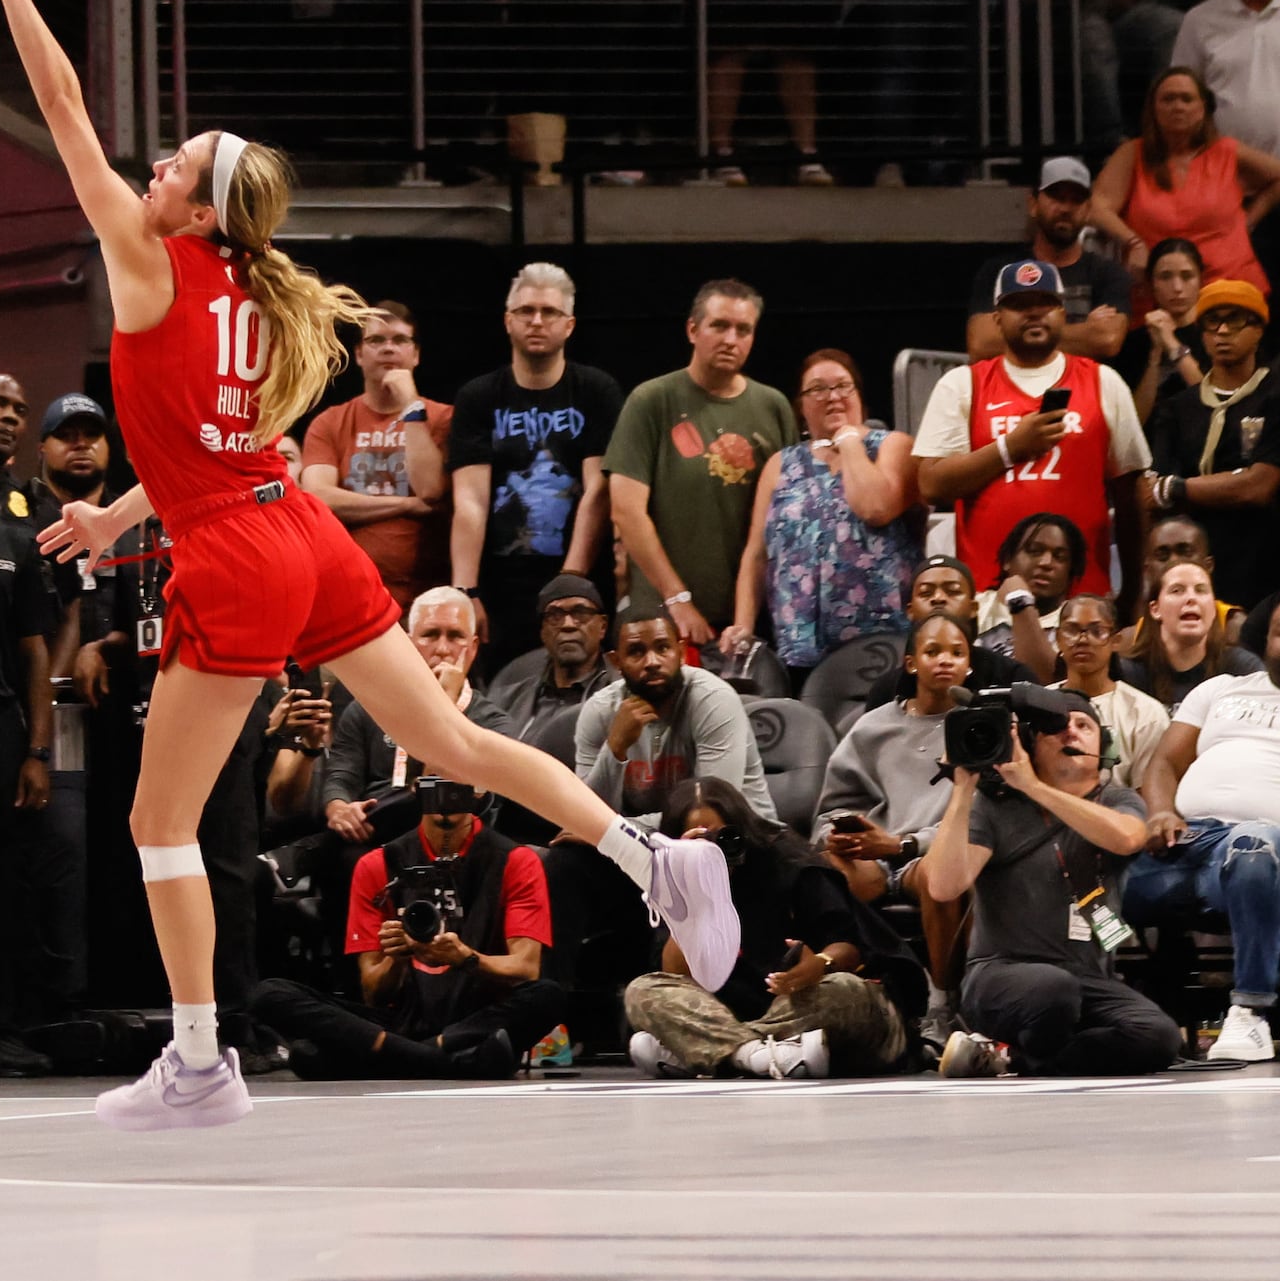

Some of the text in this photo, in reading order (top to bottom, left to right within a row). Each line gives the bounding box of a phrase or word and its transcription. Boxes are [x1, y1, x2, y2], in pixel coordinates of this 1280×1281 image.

[208, 295, 271, 382] 10
[218, 384, 251, 420] HULL
[225, 431, 266, 454] AT&
[494, 406, 586, 451] VENDED
[990, 411, 1083, 440] FER
